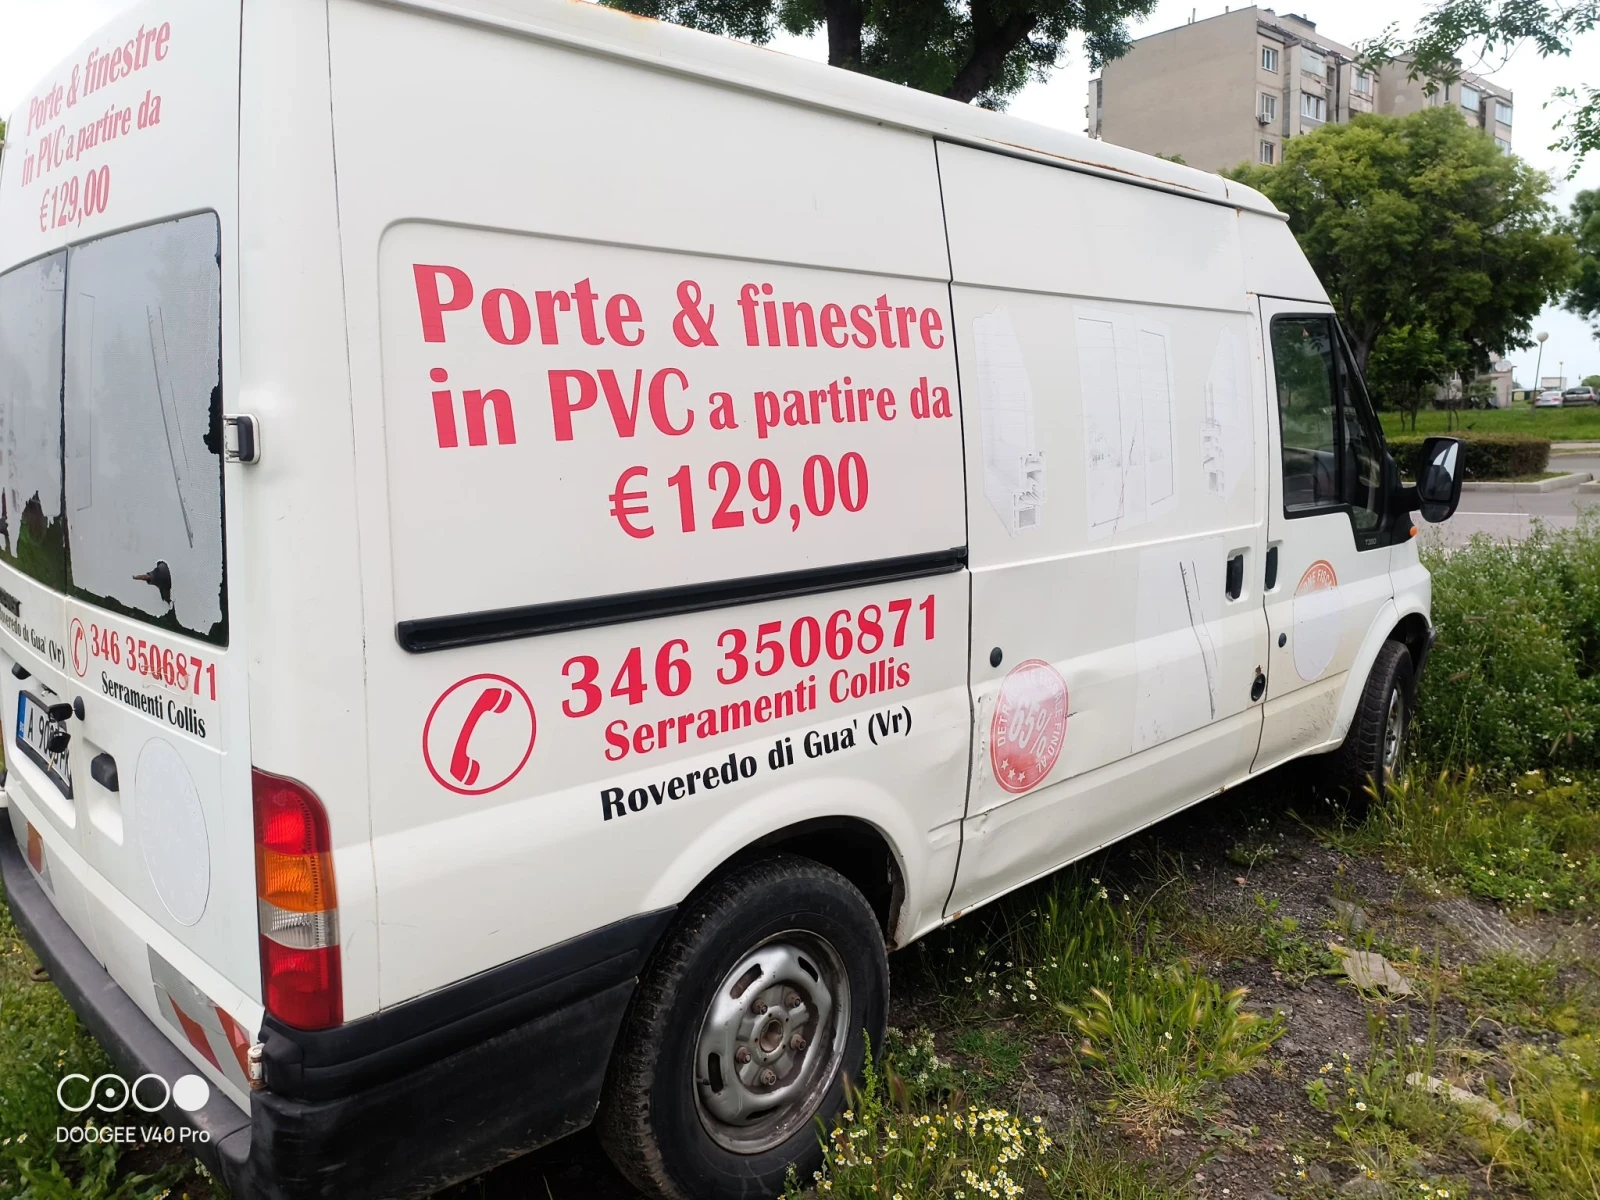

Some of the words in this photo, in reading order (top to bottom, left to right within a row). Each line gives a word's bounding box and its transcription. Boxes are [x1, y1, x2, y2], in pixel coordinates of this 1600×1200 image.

[66, 62, 81, 108] &
[83, 21, 170, 97] finestre
[21, 148, 34, 188] in
[37, 124, 66, 178] PVC
[65, 134, 75, 160] a
[77, 103, 131, 161] partire
[136, 89, 162, 130] da
[413, 264, 644, 346] Porte
[673, 278, 718, 350] &
[738, 280, 944, 352] finestre
[430, 368, 516, 448] in
[548, 368, 694, 441] PVC
[709, 392, 738, 430] a
[755, 377, 899, 439] partire
[910, 377, 952, 419] da
[48, 639, 66, 670] (Vr)
[90, 623, 120, 665] 346
[125, 635, 217, 702] 3506871
[561, 638, 693, 719] 346
[716, 593, 936, 685] 3506871
[27, 706, 34, 743] A
[101, 670, 164, 721] Serramenti
[167, 700, 207, 739] Collis
[603, 675, 817, 762] Serramenti
[828, 657, 911, 703] Collis
[1047, 722, 1063, 756] FINO
[601, 753, 758, 821] Roveredo
[769, 738, 793, 770] di
[804, 720, 860, 758] Gua'
[866, 706, 914, 745] (Vr)
